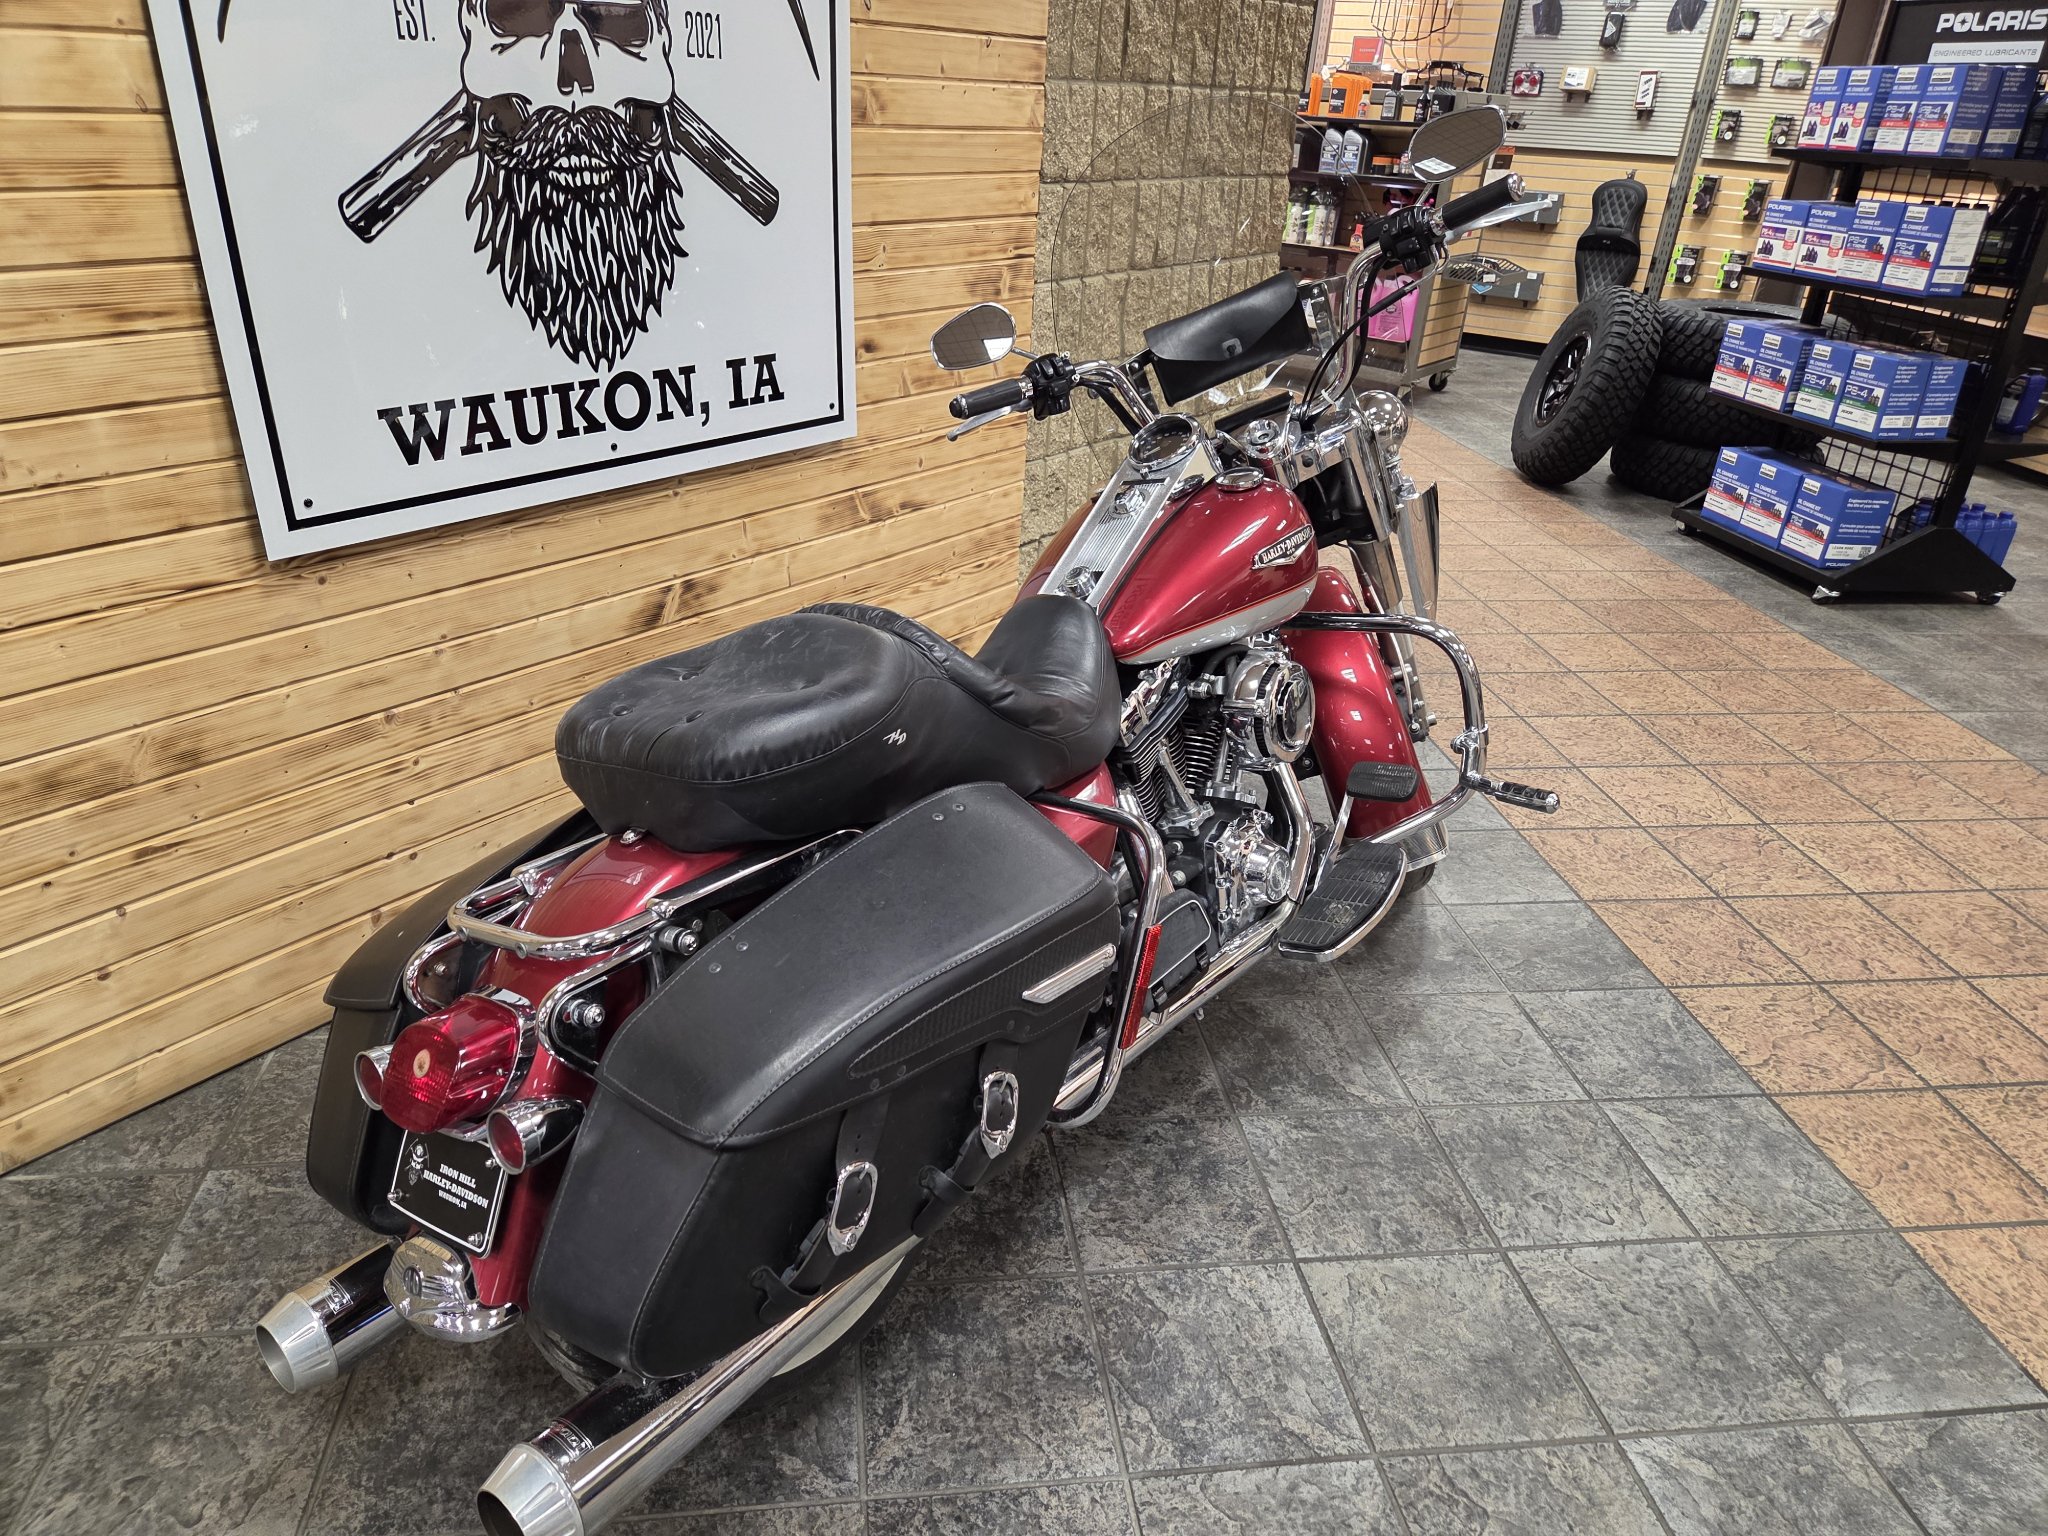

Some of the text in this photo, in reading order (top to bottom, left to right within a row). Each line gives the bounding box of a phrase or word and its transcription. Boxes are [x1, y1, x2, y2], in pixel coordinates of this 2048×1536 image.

[1936, 8, 2048, 33] POLARIS
[684, 10, 722, 59] 2021
[1933, 48, 2037, 57] ENGINEERED LUBRICANTS
[1767, 203, 1793, 212] POLARIS
[1811, 208, 1837, 218] POLARIS
[1844, 385, 1868, 398] PS-4
[377, 353, 785, 466] WAUKON, IA
[440, 1164, 476, 1188] IRON HILL
[423, 1170, 488, 1208] HARLEY-DAVIDSON
